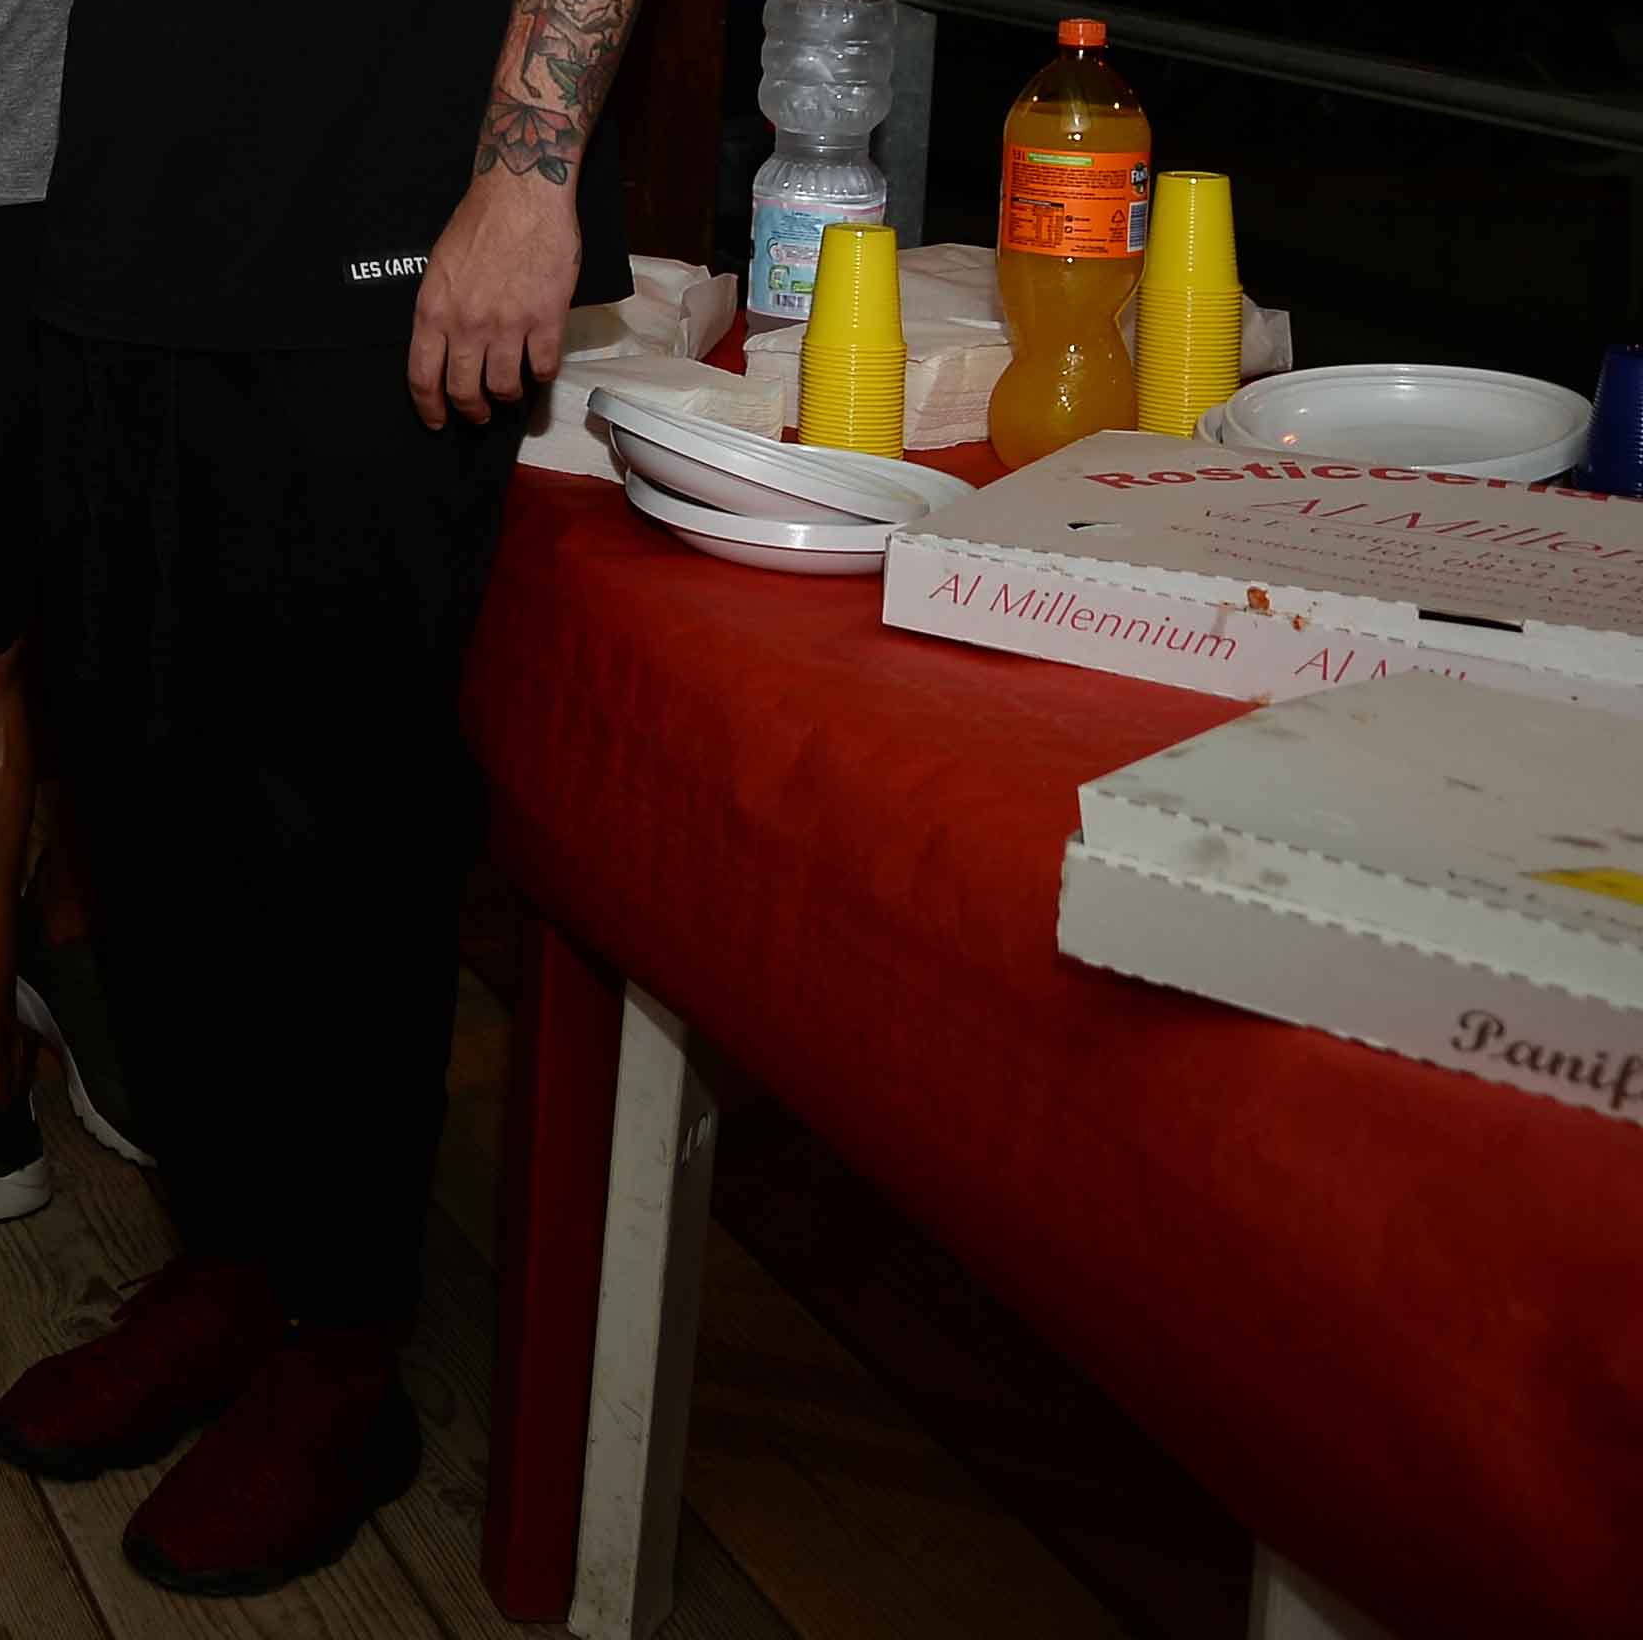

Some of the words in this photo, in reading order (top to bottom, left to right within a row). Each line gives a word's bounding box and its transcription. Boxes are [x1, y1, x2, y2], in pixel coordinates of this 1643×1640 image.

[351, 261, 382, 281] LES
[1251, 498, 1369, 518] Al
[928, 573, 982, 607] Al
[989, 583, 1238, 661] Millennium
[1295, 647, 1355, 683] Al
